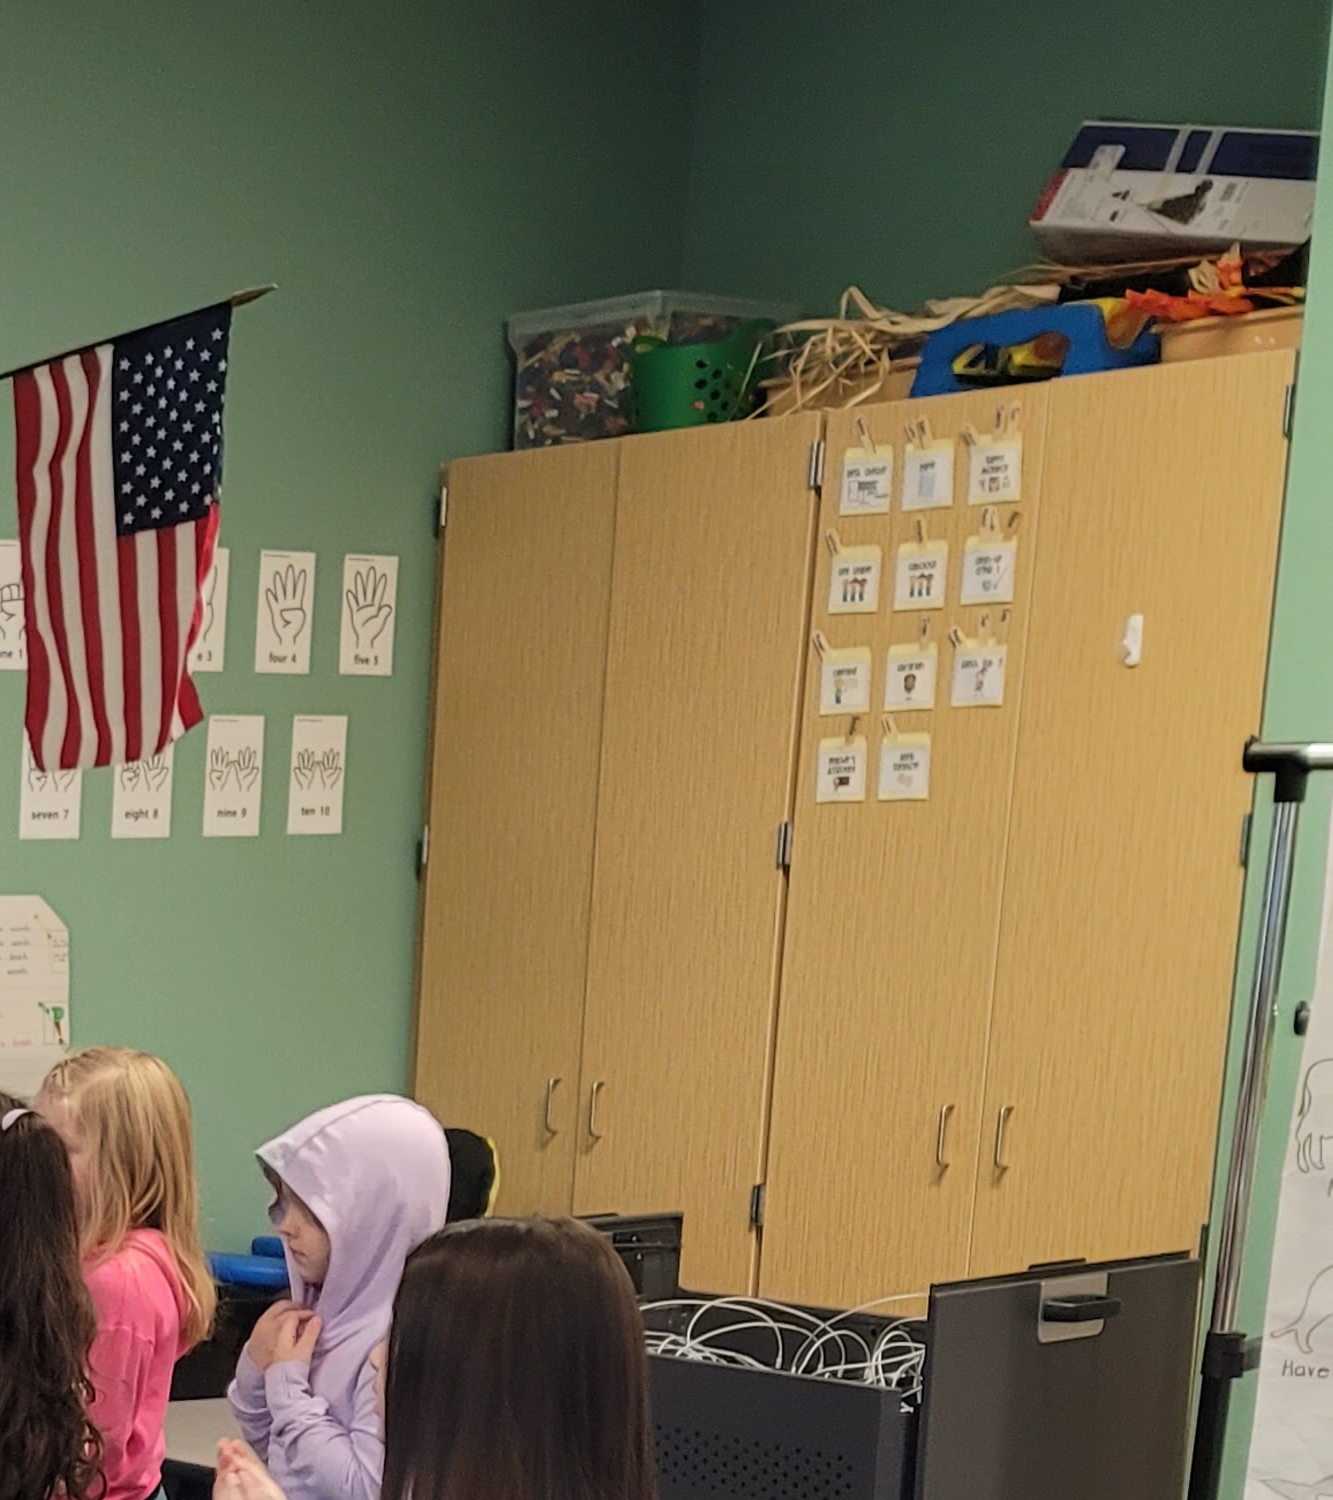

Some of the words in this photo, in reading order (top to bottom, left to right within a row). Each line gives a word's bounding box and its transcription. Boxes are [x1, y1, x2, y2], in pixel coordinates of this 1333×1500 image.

[269, 653, 288, 664] four
[354, 654, 371, 665] five
[217, 808, 238, 818] nine
[301, 807, 315, 817] ten
[1282, 1359, 1330, 1379] Have
